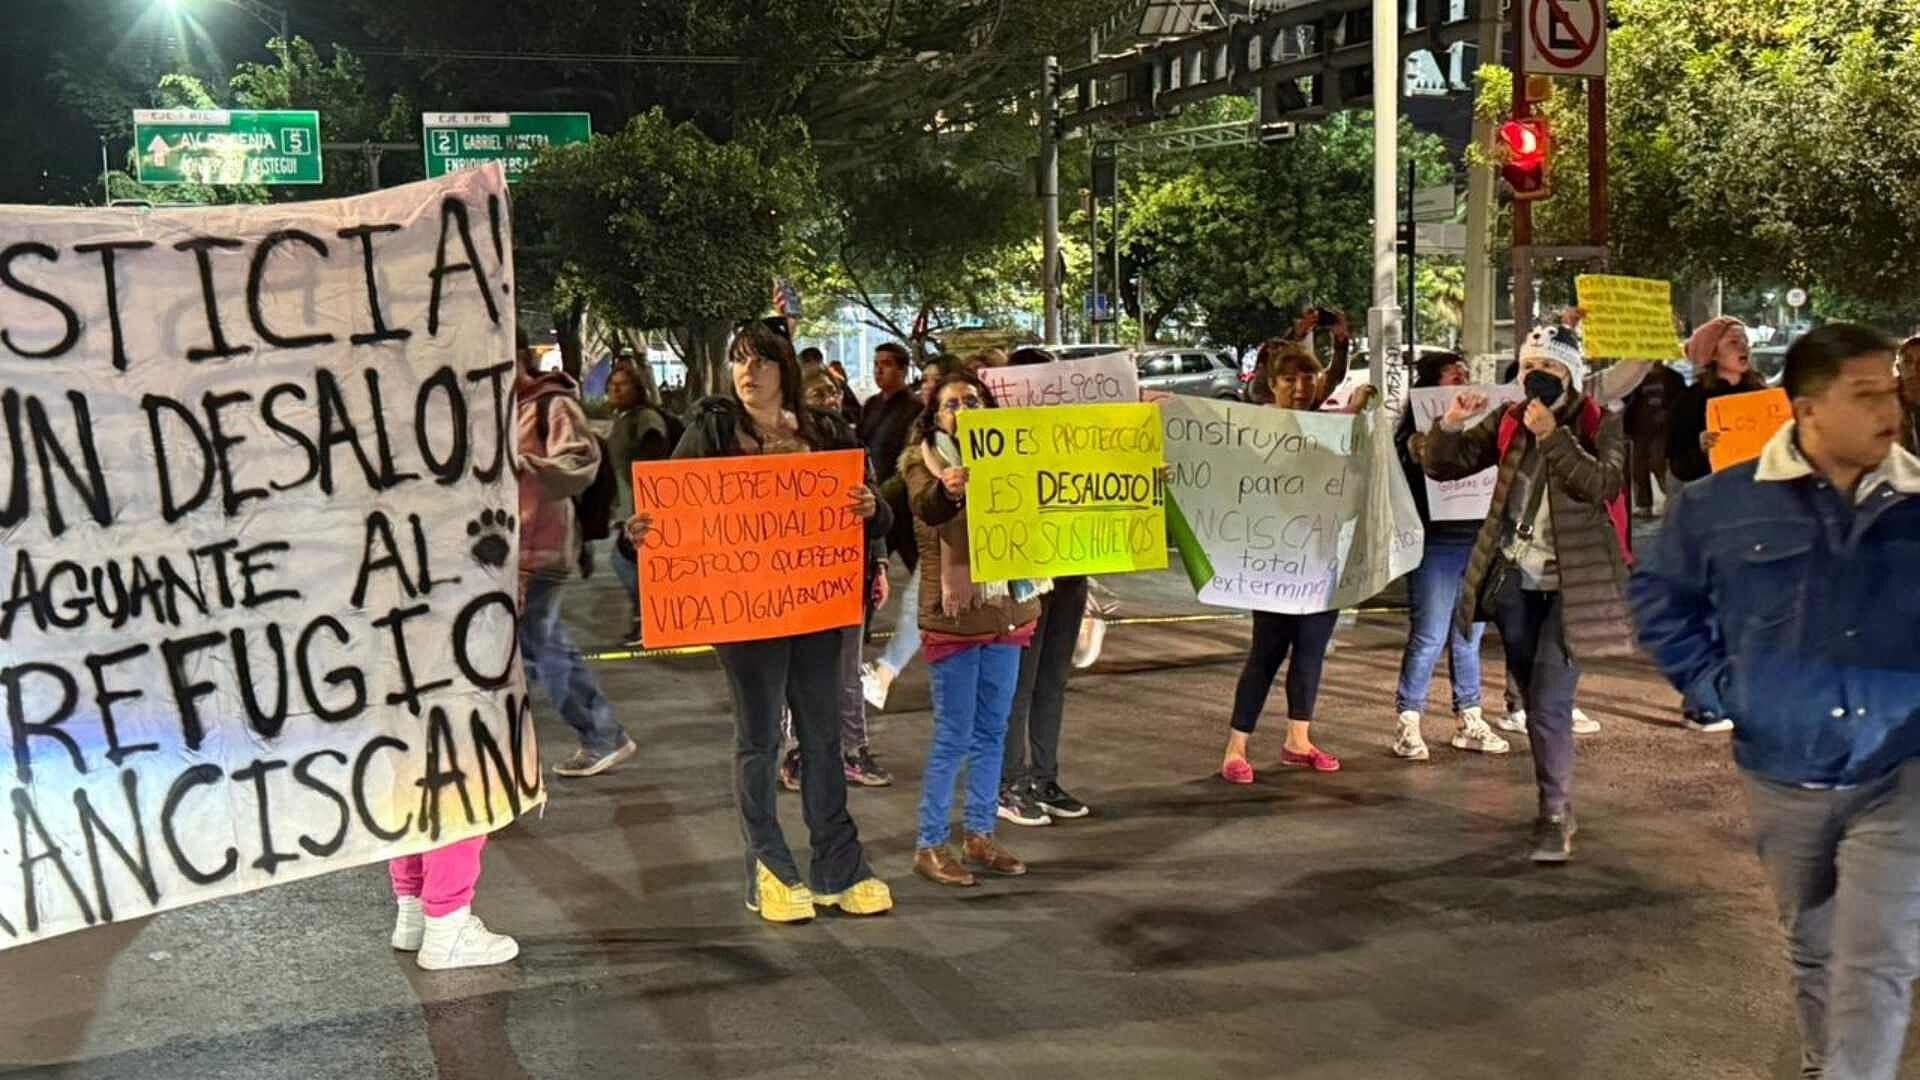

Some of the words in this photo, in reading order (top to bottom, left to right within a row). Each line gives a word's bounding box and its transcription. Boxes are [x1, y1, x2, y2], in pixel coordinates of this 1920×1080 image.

[290, 133, 304, 149] 5
[439, 135, 451, 150] 2
[968, 427, 1005, 461] NO
[1016, 427, 1041, 456] ES
[1165, 407, 1318, 464] onstruyan
[637, 475, 680, 509] NO
[682, 467, 839, 508] QUEREMOS
[985, 473, 1026, 515] ES
[1037, 467, 1164, 507] DESALOJO!!
[1238, 473, 1305, 504] para
[1324, 465, 1347, 497] el
[701, 508, 809, 546] MUNDIAL
[972, 517, 1031, 574] POR
[1033, 516, 1087, 565] SUS
[0, 539, 301, 640] AGUANTE
[350, 510, 462, 608] AL
[648, 550, 760, 583] DESPOJO
[770, 543, 859, 575] QUEREMOS
[1238, 548, 1306, 575] total
[649, 595, 716, 633] VIDA
[720, 584, 795, 625] DIGNA
[0, 591, 519, 783] REFUGIO
[0, 692, 540, 938] ANCISCANO
